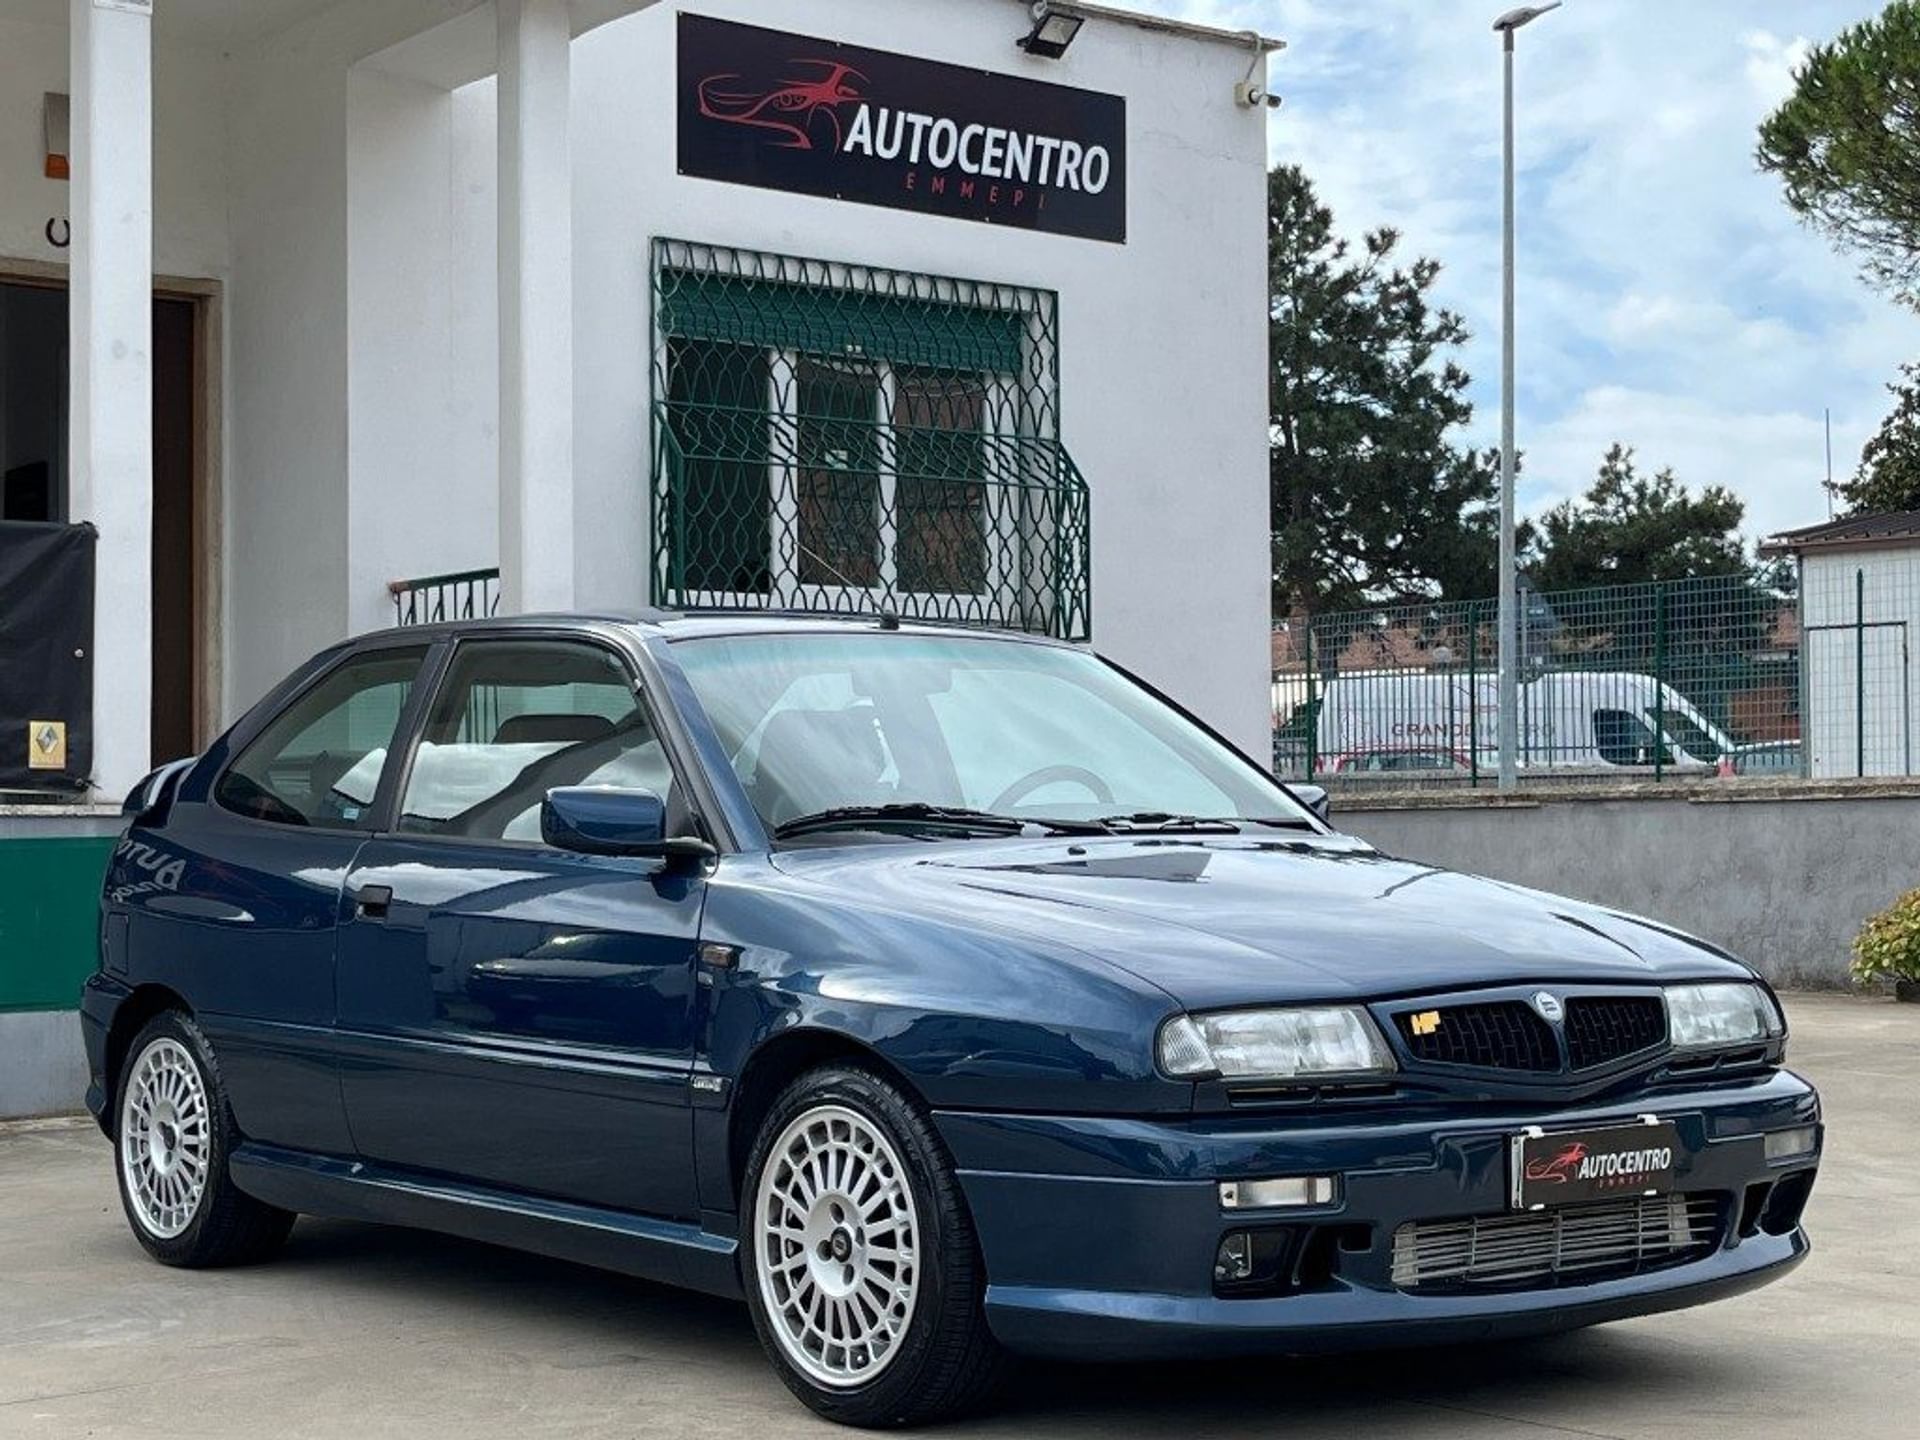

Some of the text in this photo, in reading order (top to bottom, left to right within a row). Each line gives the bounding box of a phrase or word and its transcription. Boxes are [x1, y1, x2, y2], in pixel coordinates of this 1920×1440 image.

[843, 104, 1110, 194] AUTOCENTRO
[904, 172, 1047, 210] EMMEPI
[1578, 1148, 1671, 1179] AUTOCENTRO
